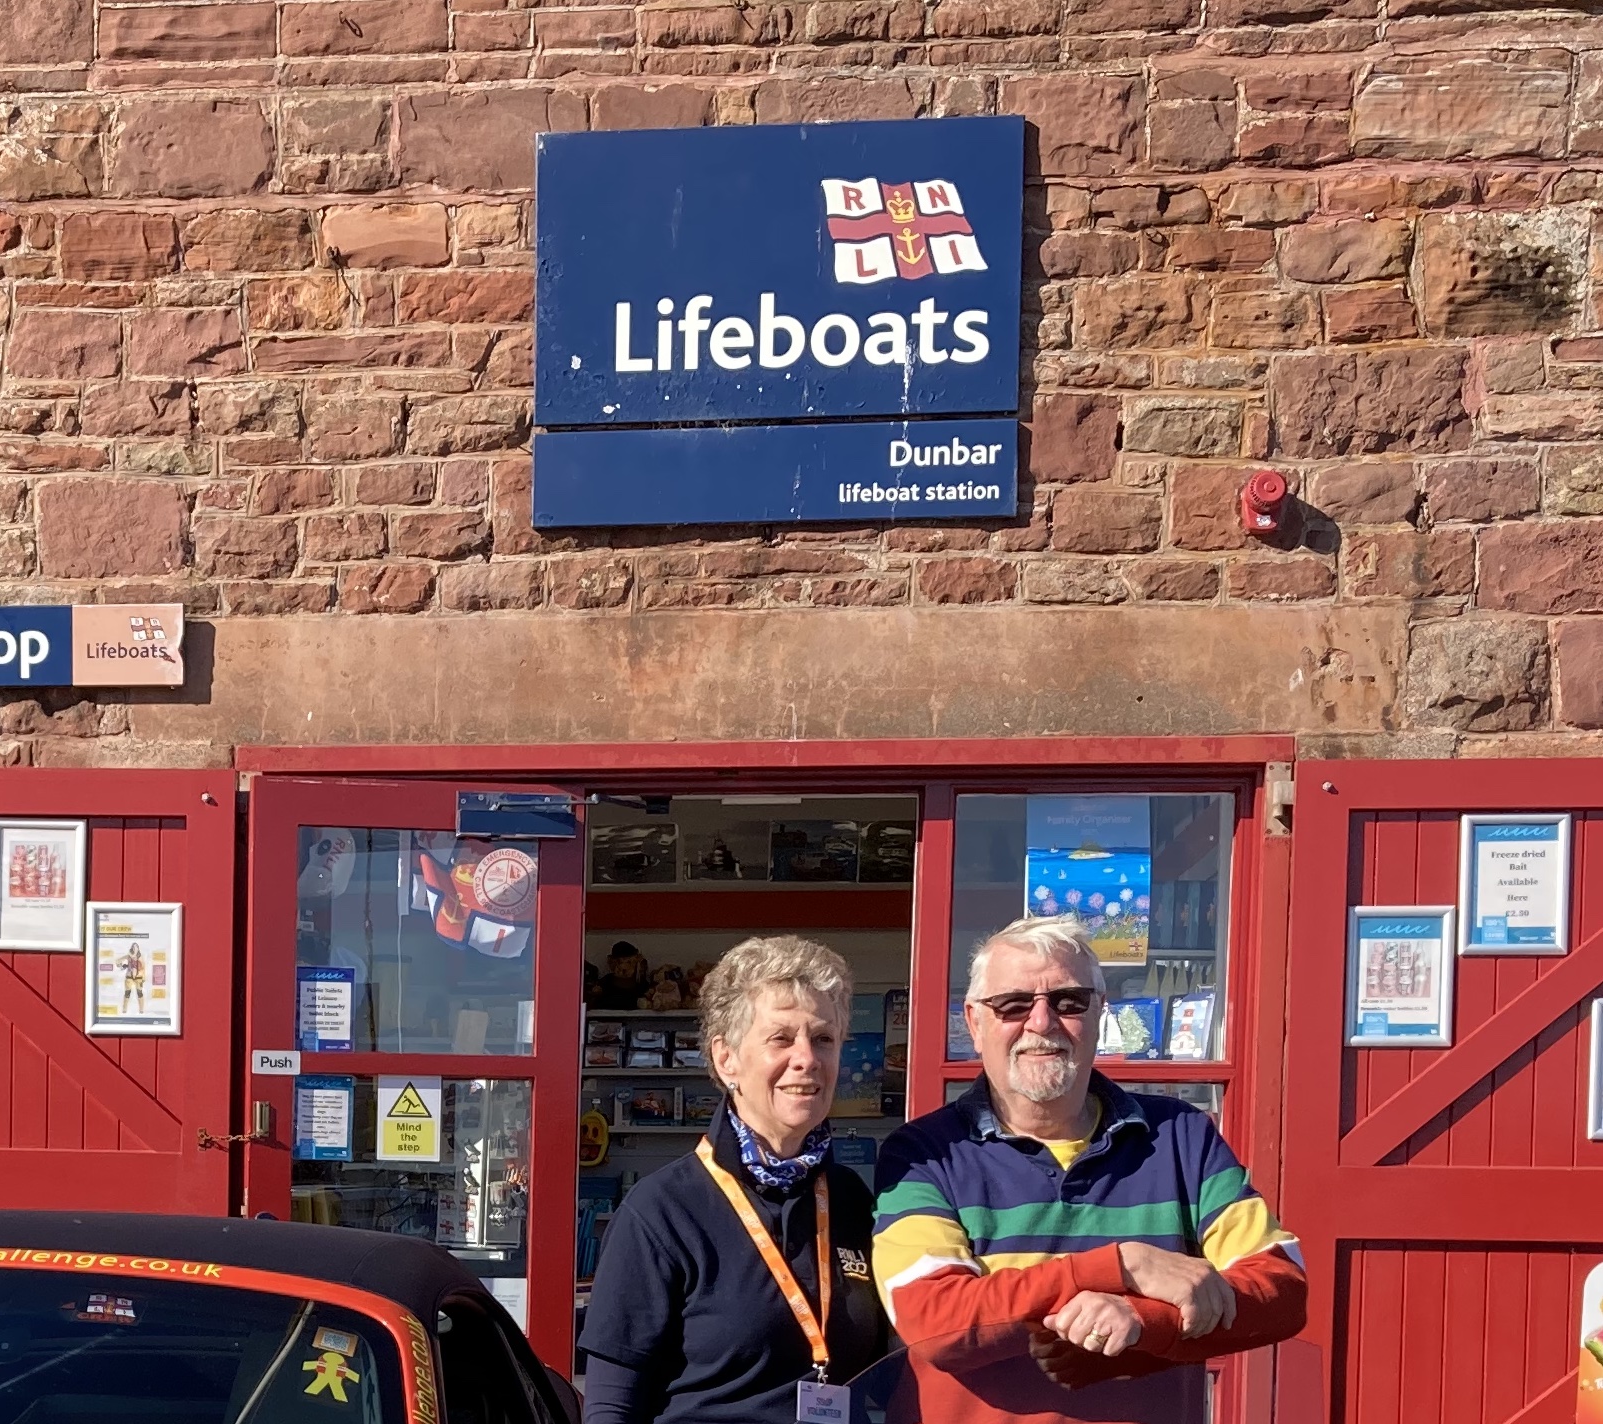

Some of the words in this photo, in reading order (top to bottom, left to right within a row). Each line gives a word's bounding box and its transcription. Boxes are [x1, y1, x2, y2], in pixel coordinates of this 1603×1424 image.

[842, 186, 863, 211] R
[927, 184, 952, 207] N
[856, 249, 878, 277] L
[952, 239, 964, 266] I
[614, 292, 990, 373] Lifeboats
[889, 437, 1002, 467] Dunbar
[838, 482, 920, 503] lifeboat
[925, 481, 1000, 501] station
[86, 641, 168, 659] Lifeboats
[1521, 850, 1546, 859] dried
[1509, 863, 1528, 871] Bait
[1497, 878, 1539, 887] Available
[1507, 894, 1528, 902] Here
[260, 1055, 293, 1069] Push
[396, 1122, 422, 1132] Mind
[400, 1132, 418, 1142] the
[397, 1143, 421, 1154] step
